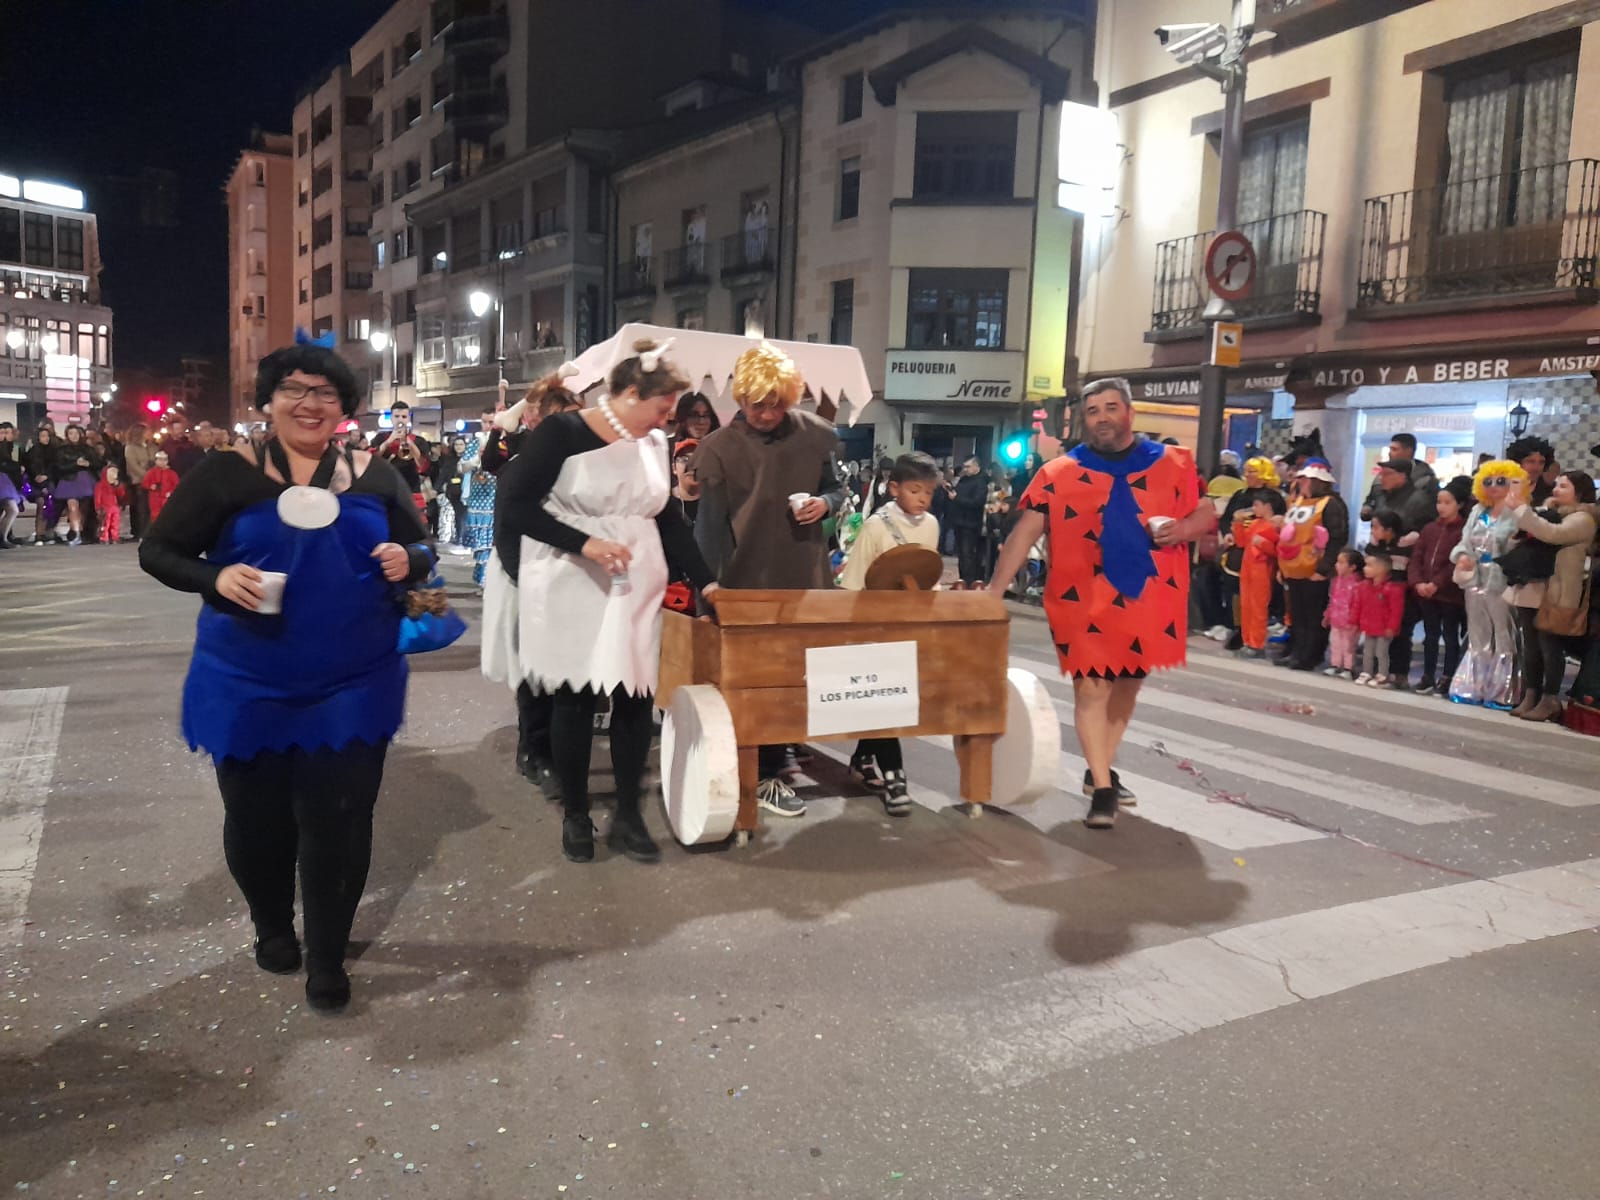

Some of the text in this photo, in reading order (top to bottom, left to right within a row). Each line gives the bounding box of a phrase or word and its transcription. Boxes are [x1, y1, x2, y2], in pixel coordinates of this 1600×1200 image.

[891, 361, 956, 375] PELUQUERIA
[1313, 358, 1510, 387] ALTO Y A BEBER
[946, 379, 1011, 399] Neme
[1144, 380, 1202, 397] SILVIAN
[865, 673, 879, 683] 10
[820, 686, 908, 703] LOS PICAPIEDRA
